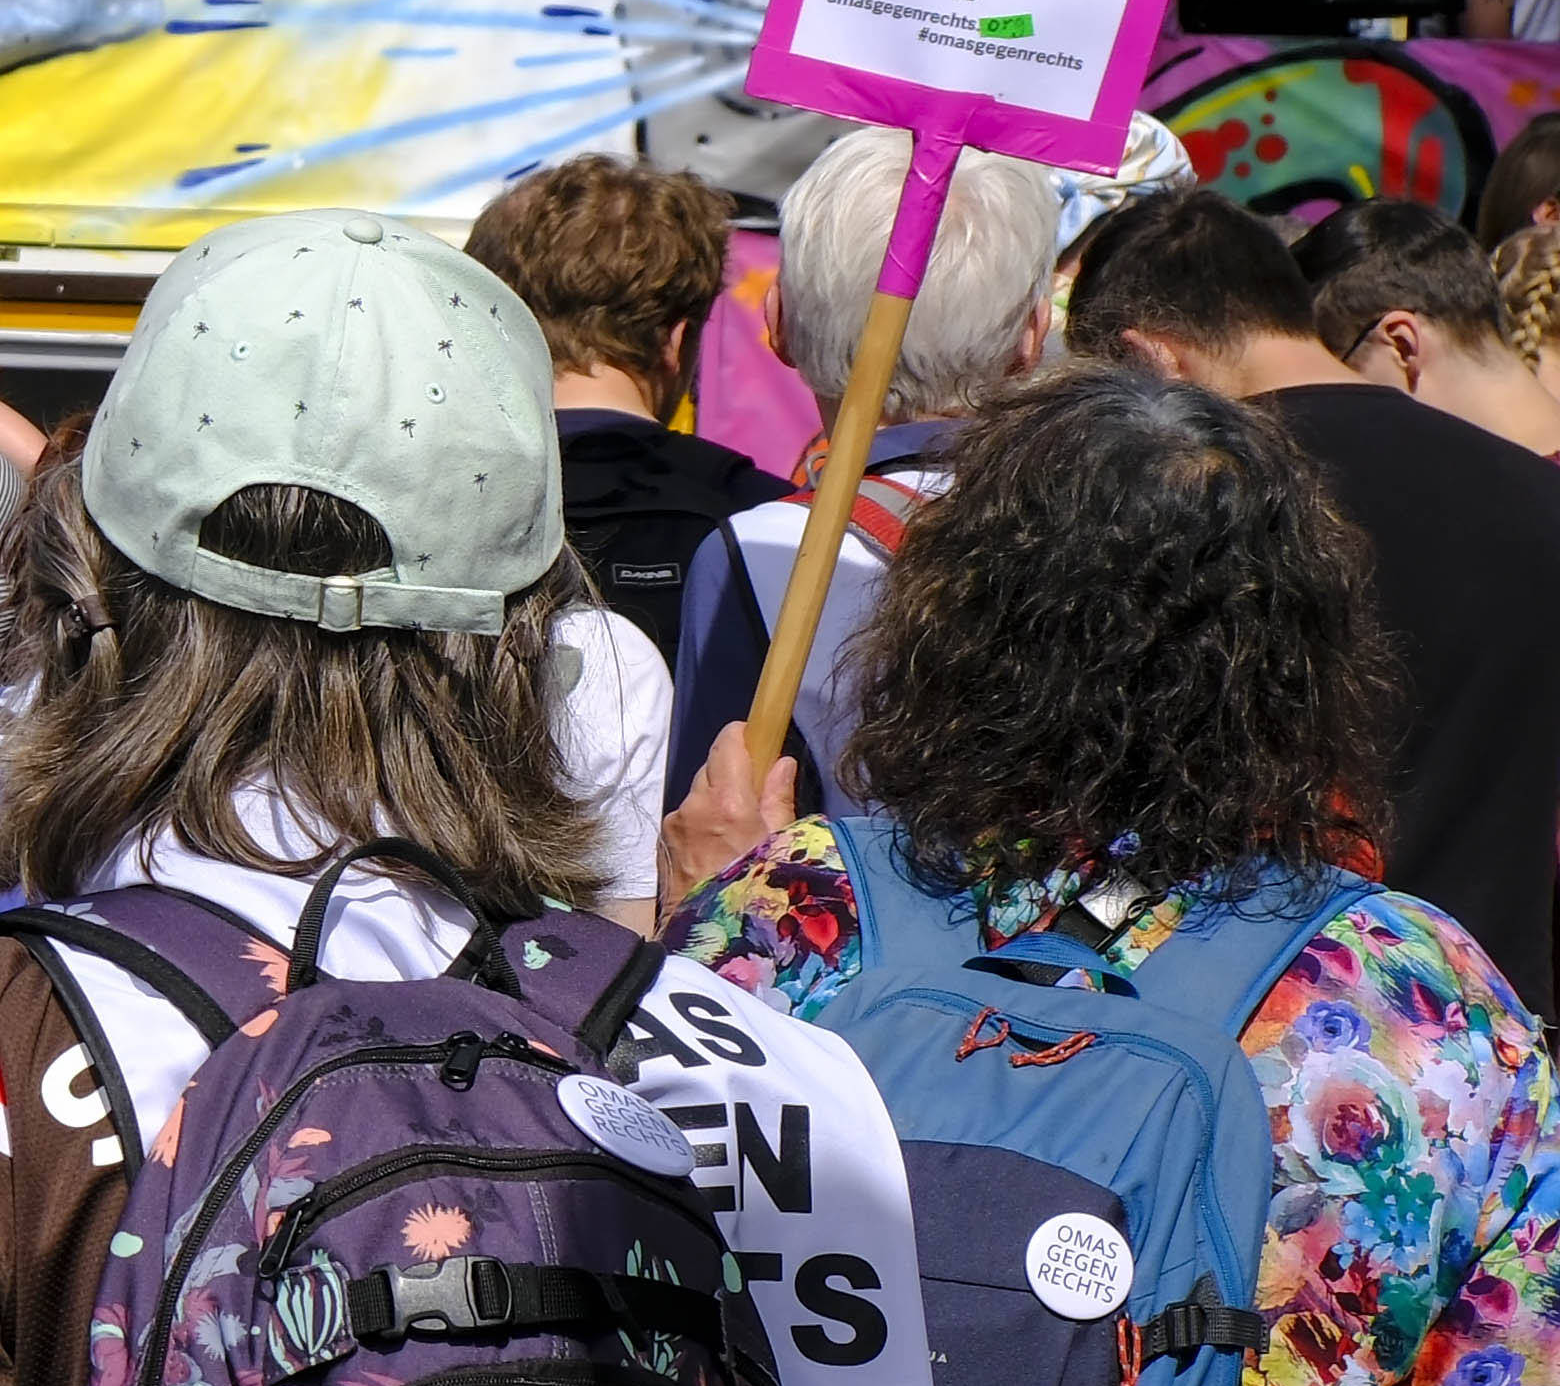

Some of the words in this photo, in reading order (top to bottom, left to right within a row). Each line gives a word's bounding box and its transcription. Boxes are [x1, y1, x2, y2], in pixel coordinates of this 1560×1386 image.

[918, 26, 1084, 71] #omasgegenrechts
[607, 991, 768, 1087] AS
[578, 1080, 655, 1115] OMAS
[584, 1097, 672, 1136] GEGEN
[591, 1114, 689, 1157] RECHTS
[1047, 1243, 1119, 1282] GEGEN
[1057, 1224, 1120, 1261] OMAS
[1036, 1262, 1116, 1305] RECHTS
